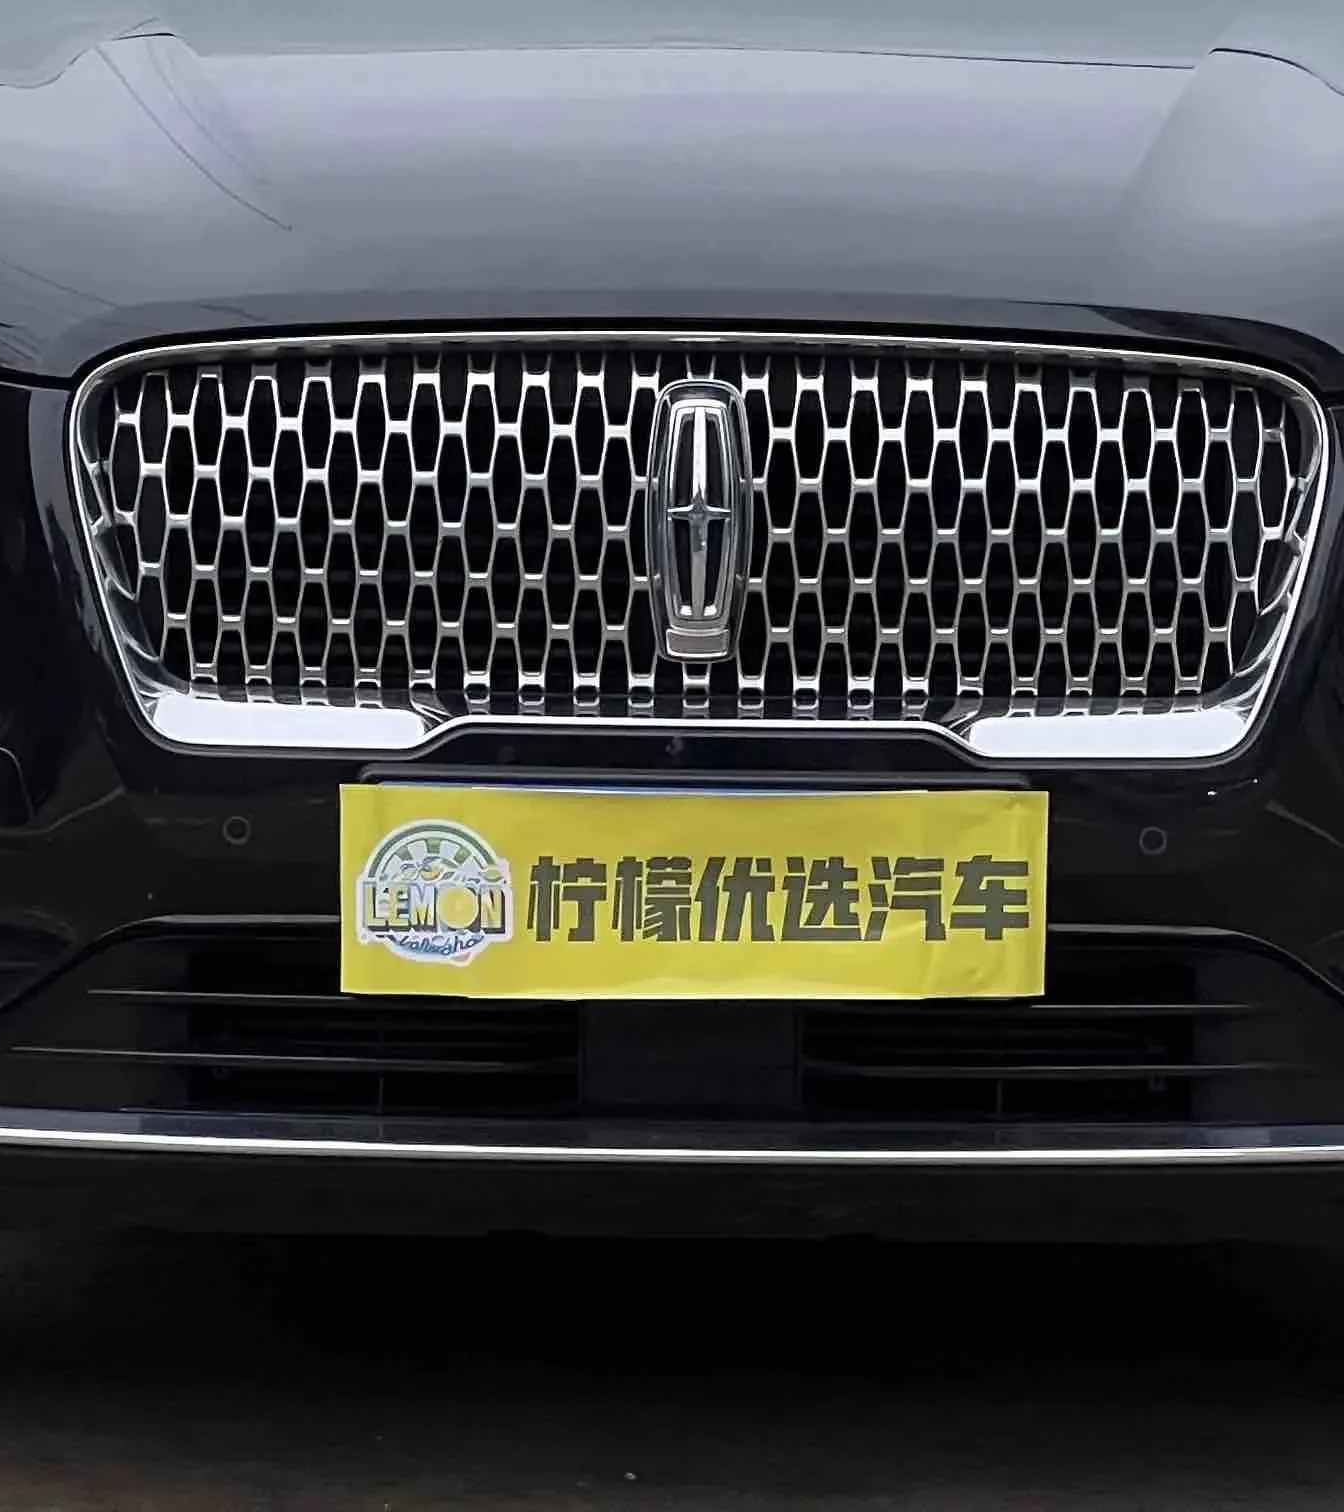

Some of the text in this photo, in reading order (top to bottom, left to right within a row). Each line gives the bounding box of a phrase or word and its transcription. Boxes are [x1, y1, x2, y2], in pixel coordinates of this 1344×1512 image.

[362, 881, 505, 934] LEMON
[527, 855, 1031, 943] 柠檬优选汽车
